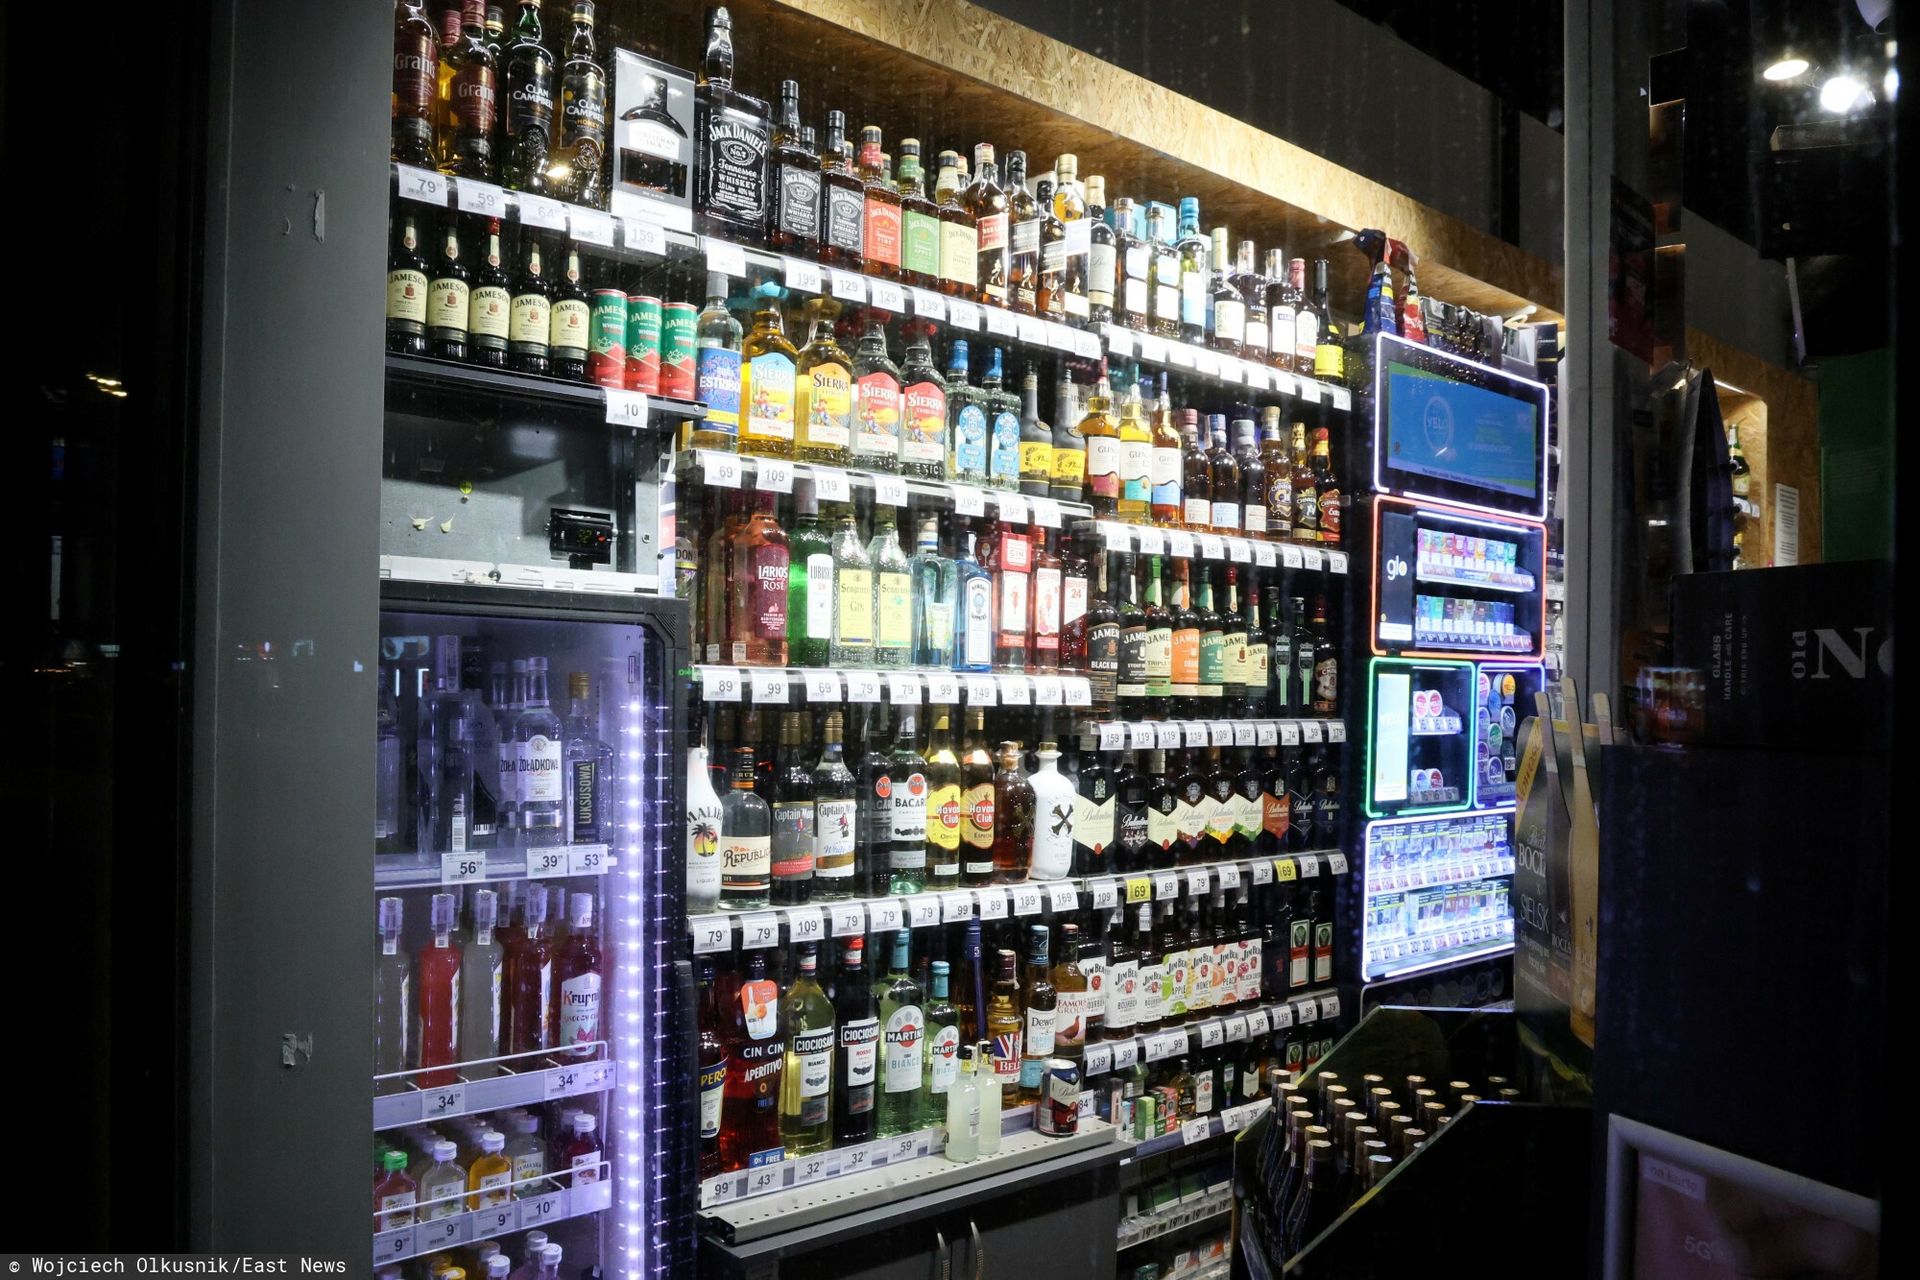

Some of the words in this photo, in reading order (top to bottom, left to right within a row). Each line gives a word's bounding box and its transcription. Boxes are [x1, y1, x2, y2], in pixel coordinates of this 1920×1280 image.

[525, 84, 548, 96] CLAN
[513, 91, 553, 110] CAMPBELL
[579, 99, 600, 112] CLAN
[566, 106, 604, 124] CAMPBELL
[709, 124, 732, 141] JACK
[733, 123, 767, 158] DANIEL'S
[719, 174, 756, 189] WHISKEY
[784, 174, 798, 184] JACK
[418, 178, 436, 193] 79
[478, 193, 495, 206] 59
[840, 280, 858, 292] 129
[880, 290, 897, 304] 129
[813, 373, 849, 391] SIERRA
[862, 381, 898, 401] SIERRA
[908, 392, 943, 410] SIERRA
[624, 403, 639, 416] 10
[719, 465, 733, 477] 69
[765, 470, 784, 482] 109
[820, 479, 837, 491] 119
[758, 566, 788, 580] LARIOS
[1724, 612, 1733, 640] CARE
[1712, 634, 1721, 678] GLASS
[1723, 655, 1733, 700] HANDLE
[719, 680, 733, 692] 89
[767, 683, 781, 695] 99
[818, 682, 832, 694] 69
[861, 684, 873, 694] 79
[940, 685, 952, 695] 99
[974, 687, 990, 698] 149
[1106, 733, 1120, 744] 159
[1137, 733, 1150, 742] 119
[1163, 731, 1176, 741] 119
[1190, 731, 1202, 741] 119
[1215, 730, 1227, 741] 109
[578, 763, 592, 824] LUKSUSOWA
[775, 809, 800, 822] Captain
[819, 805, 844, 817] Captain
[943, 815, 958, 824] Club
[977, 814, 992, 823] Club
[542, 855, 558, 869] 39
[584, 854, 599, 867] 53
[460, 861, 477, 875] 56
[1282, 865, 1291, 877] 69
[1135, 885, 1146, 897] 69
[1165, 882, 1173, 892] 69
[1020, 896, 1035, 906] 189
[1057, 893, 1072, 903] 169
[1097, 892, 1111, 903] 109
[957, 905, 968, 916] 99
[990, 900, 1001, 910] 89
[882, 912, 895, 922] 79
[922, 907, 933, 918] 79
[798, 920, 817, 932] 109
[845, 916, 858, 927] 79
[708, 931, 722, 942] 79
[757, 928, 771, 939] 79
[887, 1029, 923, 1041] MARTIN
[1210, 1030, 1219, 1041] 99
[743, 1047, 762, 1058] CIN
[767, 1042, 784, 1054] CIN
[1173, 1039, 1183, 1049] 99
[1123, 1049, 1131, 1059] 99
[1092, 1057, 1105, 1068] 139
[744, 1058, 782, 1083] APERITIVO
[558, 1074, 574, 1088] 34
[438, 1094, 455, 1108] 34
[1197, 1123, 1206, 1136] 36
[900, 1141, 912, 1153] 59
[766, 1154, 780, 1164] FREE
[852, 1152, 864, 1165] 32
[807, 1162, 820, 1175] 32
[758, 1174, 771, 1186] 43
[714, 1182, 729, 1195] 99
[536, 1201, 551, 1215] 10
[498, 1213, 506, 1226] 9
[446, 1224, 455, 1237] 9
[395, 1239, 403, 1252] 9
[1683, 1235, 1712, 1261] 5G
